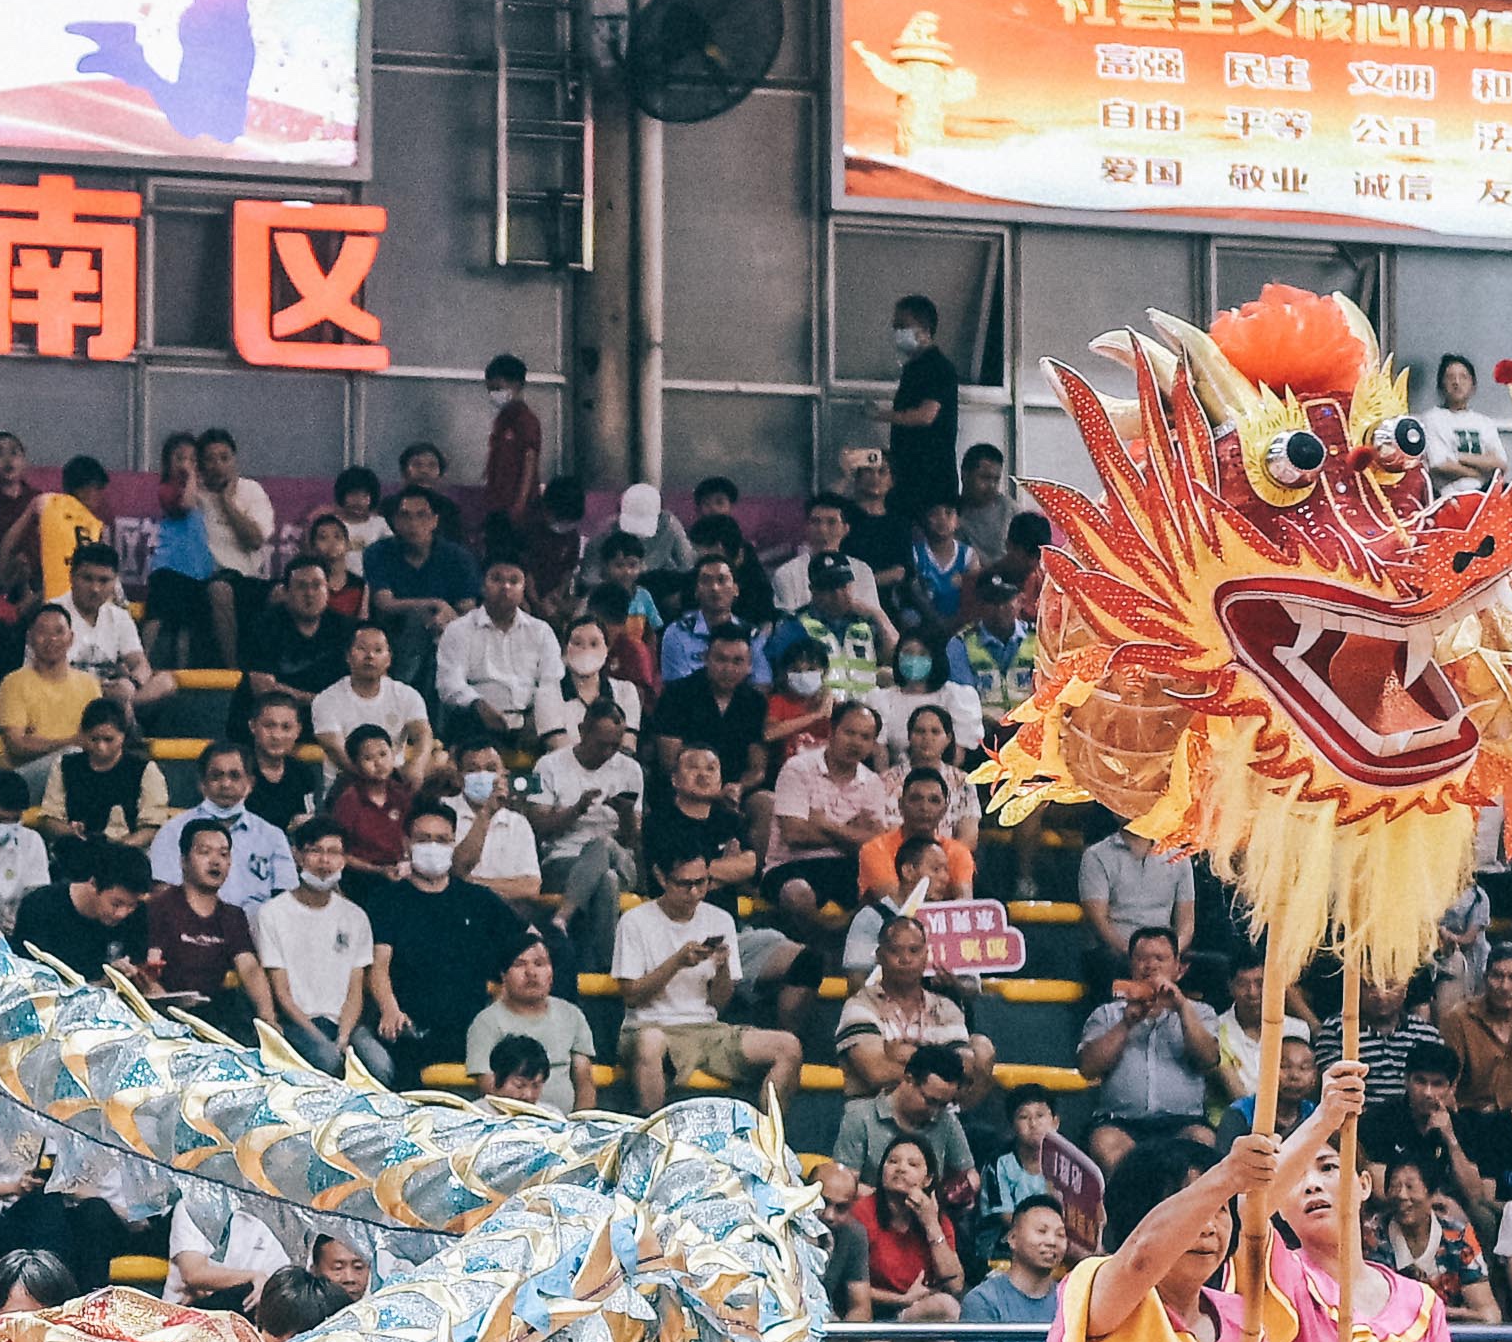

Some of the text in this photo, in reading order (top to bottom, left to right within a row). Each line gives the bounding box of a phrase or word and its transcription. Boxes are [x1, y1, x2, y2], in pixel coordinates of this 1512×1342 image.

[1096, 41, 1185, 86] 富强
[1225, 49, 1311, 93] 民主
[1348, 60, 1435, 103] 文明
[1098, 99, 1183, 134] 自由
[1225, 105, 1311, 141] 平等
[1351, 113, 1433, 149] 公正
[1100, 157, 1183, 190] 爱国
[1226, 162, 1309, 197] 敬业
[1351, 170, 1433, 205] 诚信
